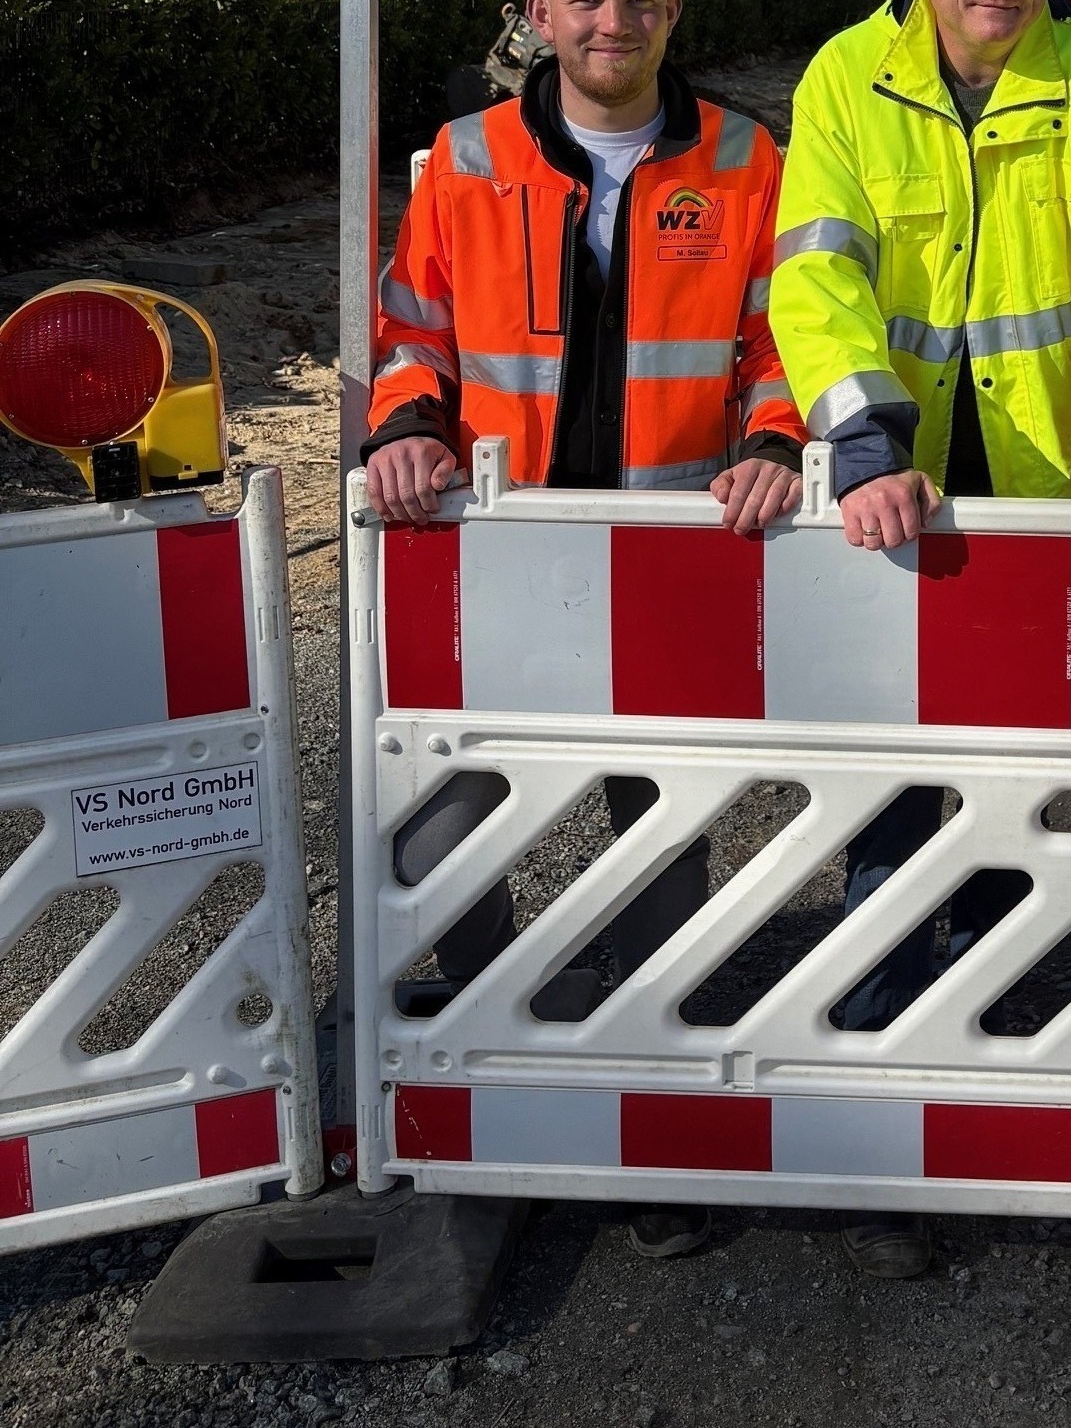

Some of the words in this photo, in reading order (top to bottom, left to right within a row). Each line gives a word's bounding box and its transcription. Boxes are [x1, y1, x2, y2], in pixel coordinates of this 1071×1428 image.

[76, 792, 108, 814] VS
[118, 782, 174, 808] Nord
[184, 768, 254, 797] GmbH
[82, 802, 212, 832] Verkehrssicherung
[219, 794, 252, 810] Nord
[90, 828, 249, 864] www.vs-nord-gmbh.de
